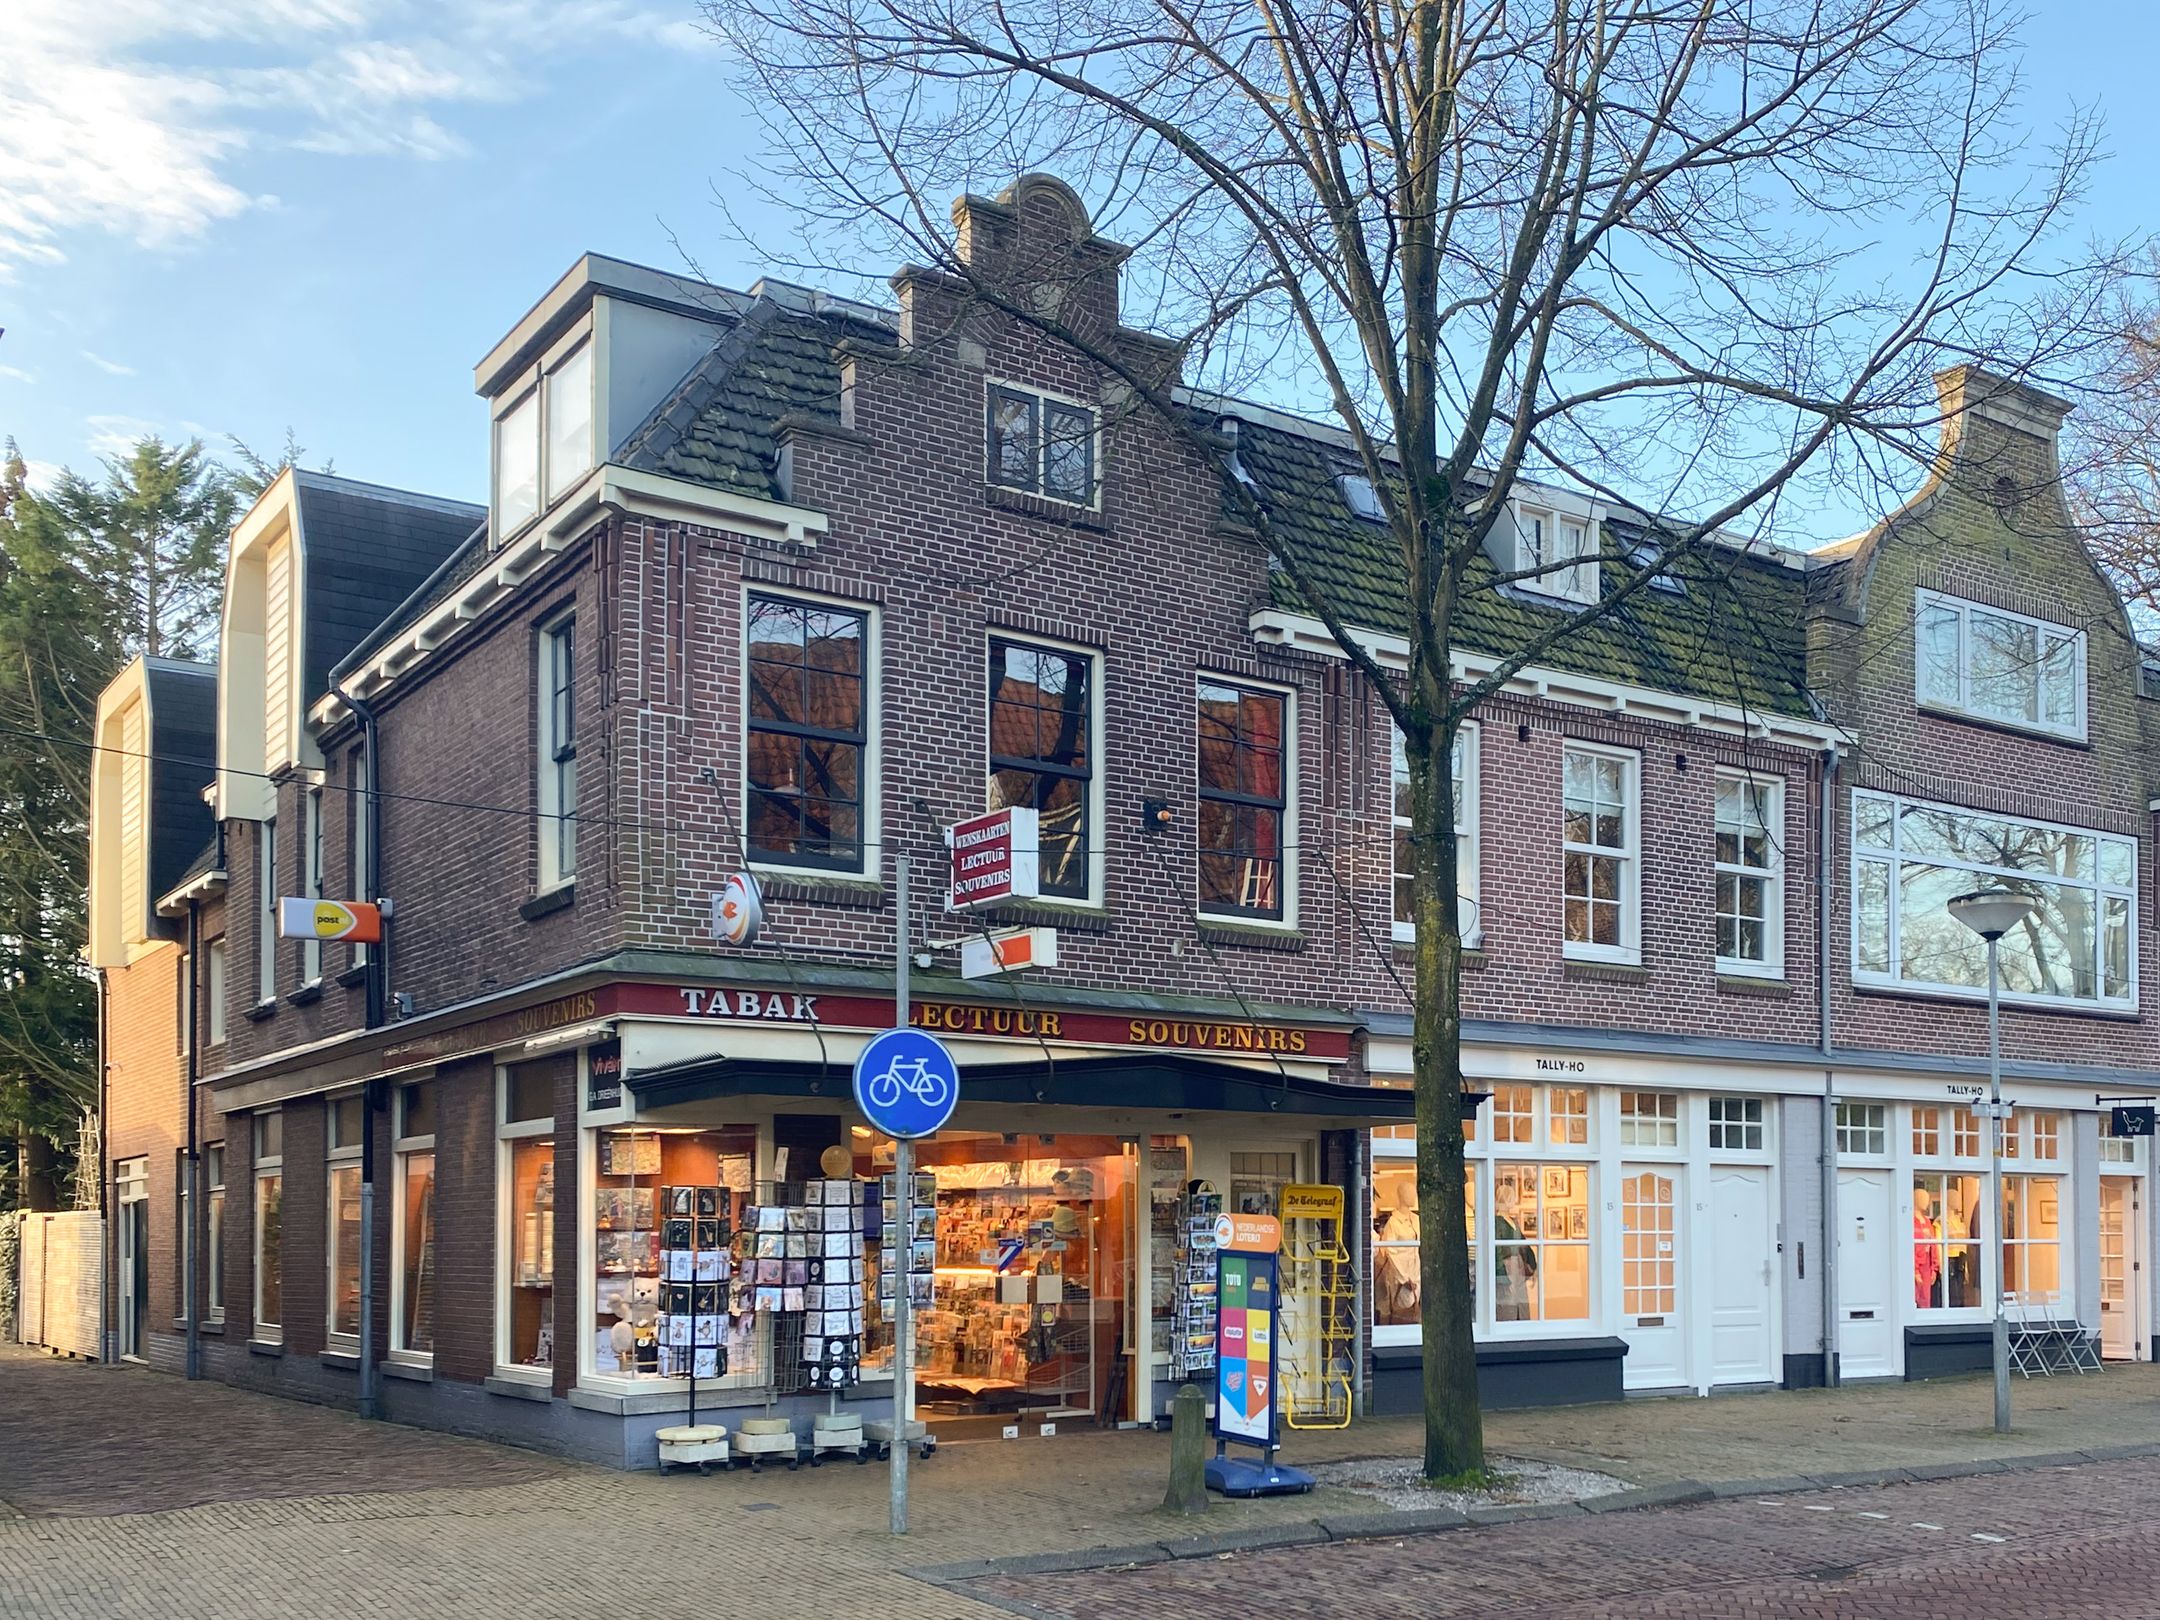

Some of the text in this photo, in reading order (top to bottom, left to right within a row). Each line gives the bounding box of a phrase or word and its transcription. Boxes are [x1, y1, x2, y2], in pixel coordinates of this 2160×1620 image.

[956, 821, 1010, 848] WENSKAARTEN
[961, 847, 1005, 871] LECTUUR
[955, 869, 1010, 895] SOUVENIRS
[680, 989, 819, 1020] TABAK
[1129, 1020, 1306, 1052] SOUVENIRS
[1536, 1060, 1584, 1072] TALLY-HO
[1947, 1085, 1984, 1096] TALLY-HO
